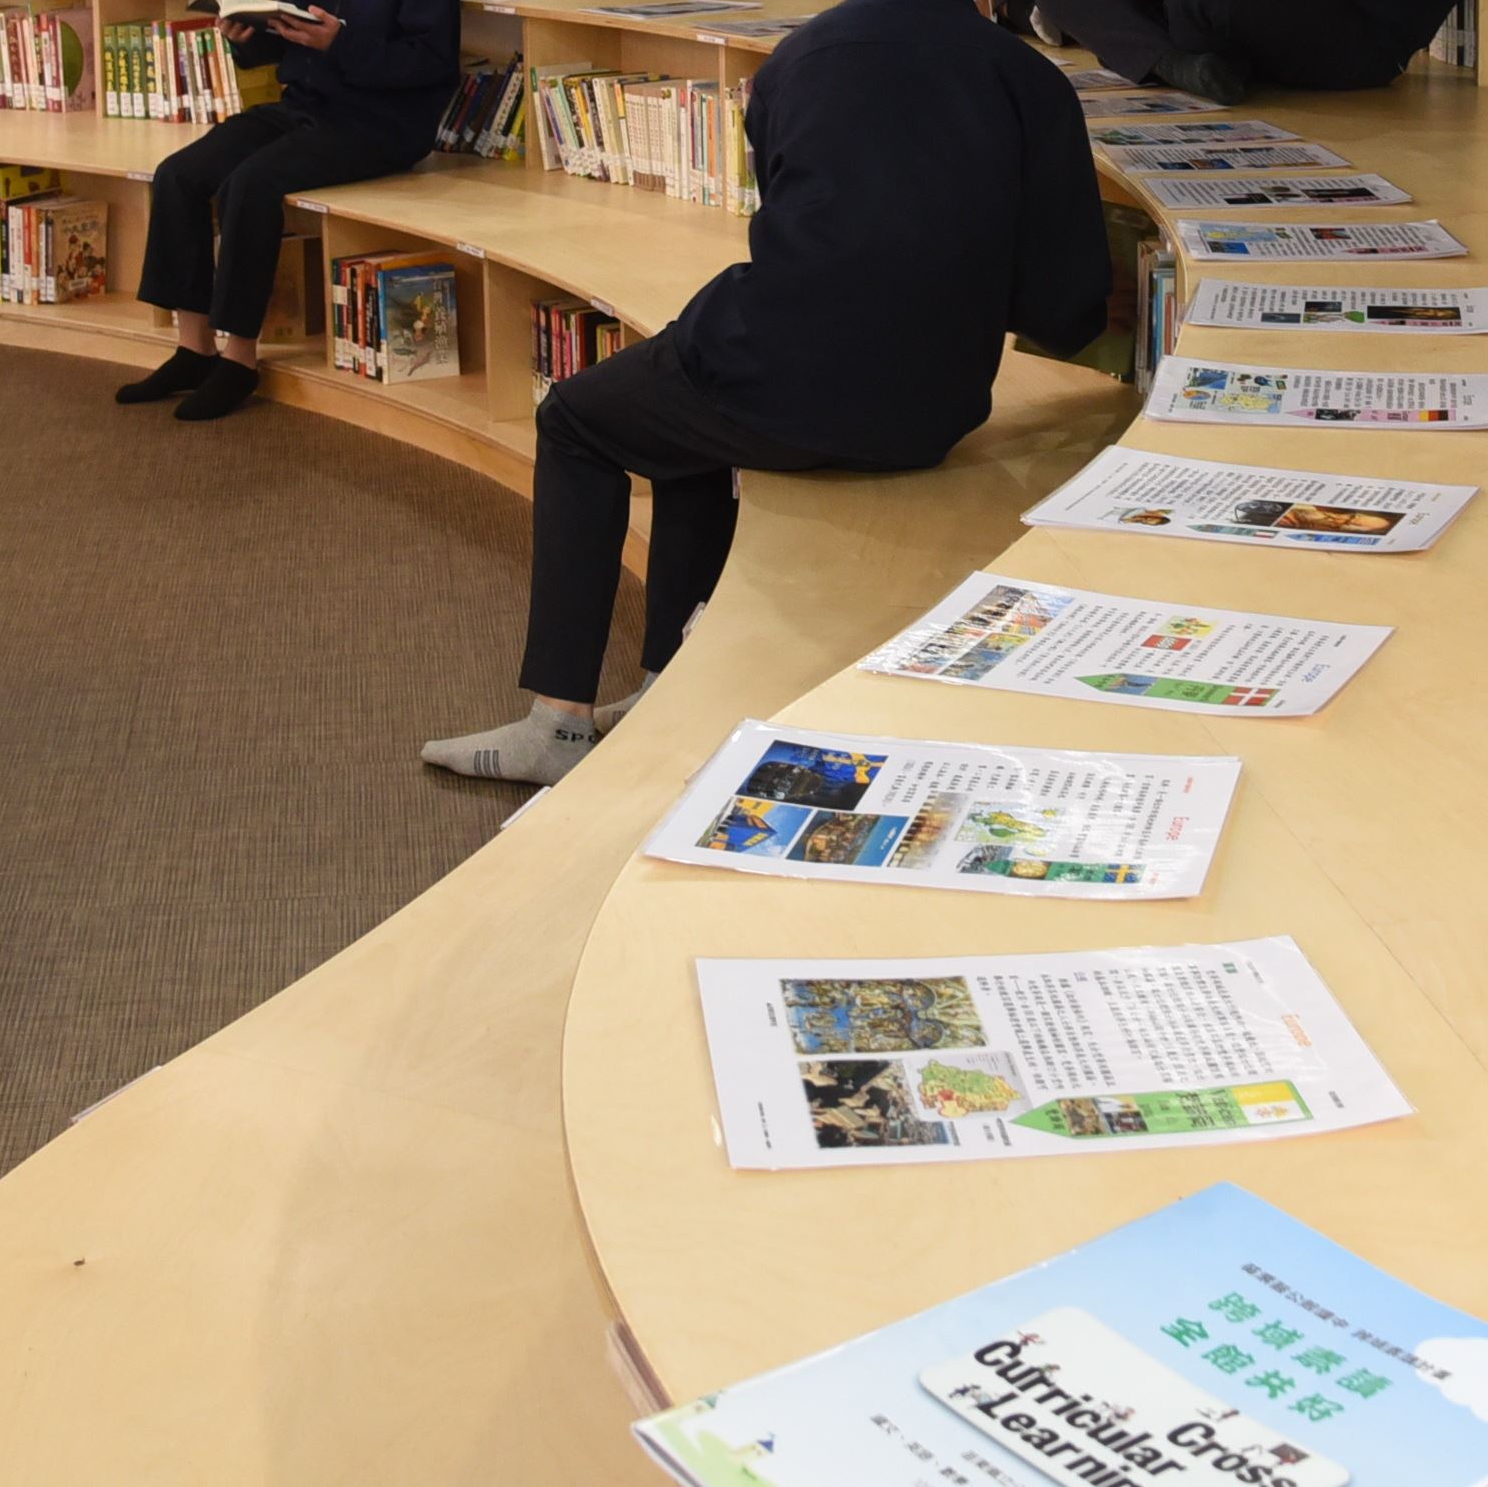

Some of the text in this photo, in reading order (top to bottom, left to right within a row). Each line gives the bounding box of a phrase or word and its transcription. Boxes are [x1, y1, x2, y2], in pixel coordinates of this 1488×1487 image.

[973, 1338, 1188, 1477] Curricular
[1159, 1316, 1345, 1424] 全館共好
[1167, 1420, 1299, 1487] Cross
